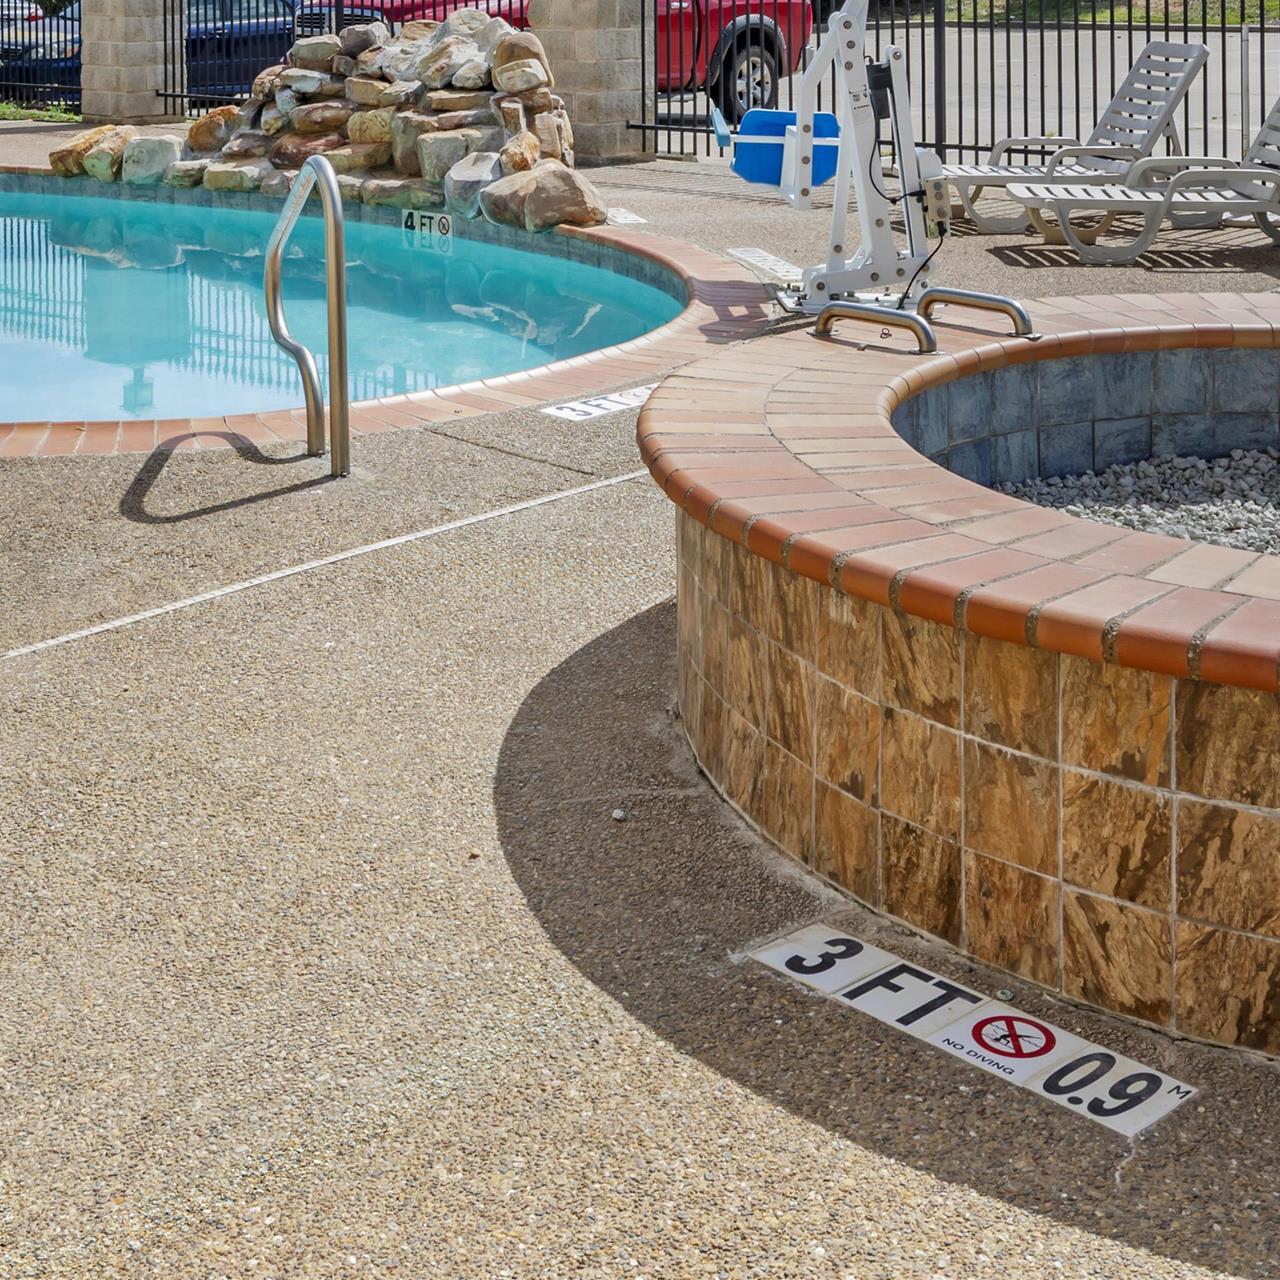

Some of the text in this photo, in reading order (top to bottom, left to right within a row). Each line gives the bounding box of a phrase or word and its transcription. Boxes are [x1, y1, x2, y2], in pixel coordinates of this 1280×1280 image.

[404, 211, 434, 234] 4 FT
[555, 396, 631, 417] 3 FT
[785, 938, 1192, 1117] 3 FT 0.9 M
[942, 1038, 1015, 1075] NO DIVING
